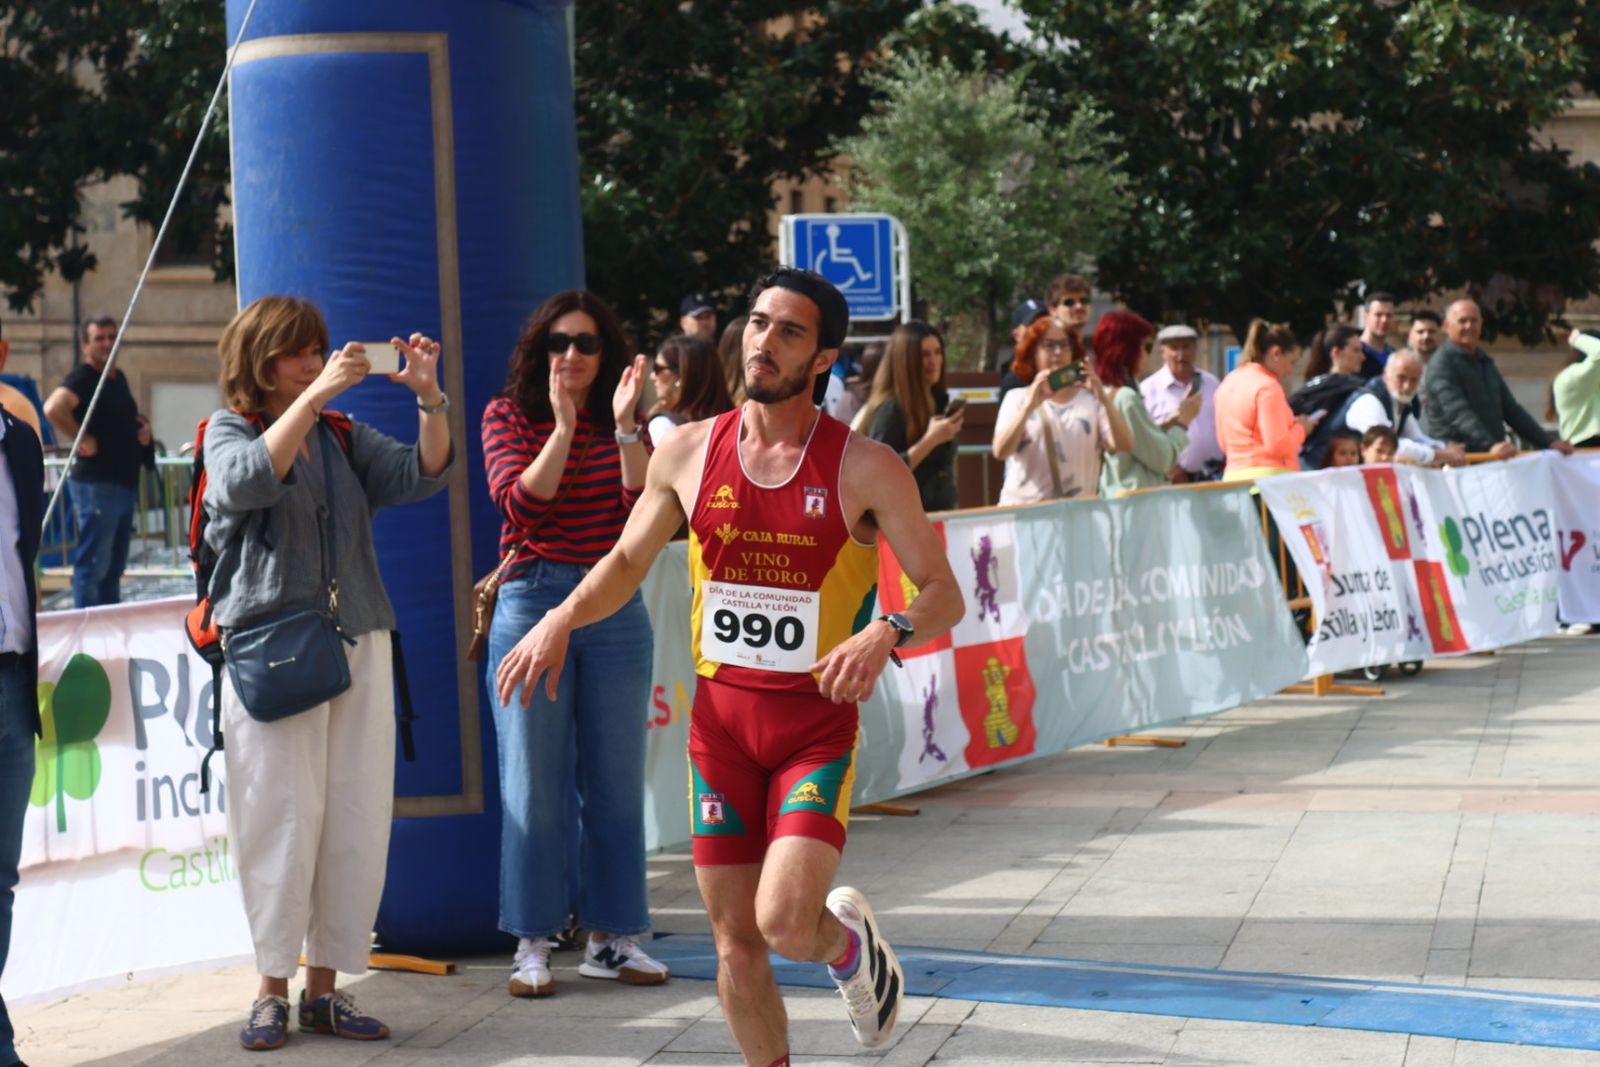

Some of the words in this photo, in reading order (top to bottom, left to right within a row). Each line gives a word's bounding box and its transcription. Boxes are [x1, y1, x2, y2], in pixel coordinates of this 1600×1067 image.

[742, 530, 773, 543] CAJA
[777, 533, 817, 546] RURAL
[1461, 509, 1551, 557] Plena
[740, 552, 790, 568] VINO
[1477, 546, 1557, 587] inclusión
[724, 567, 749, 581] DE
[753, 568, 808, 585] TORO
[709, 586, 724, 595] DÍA
[726, 589, 737, 597] DE
[740, 591, 751, 599] LA
[753, 591, 813, 604] COMUNIDAD
[721, 598, 762, 610] CASTILLA
[764, 603, 771, 611] Y
[772, 602, 798, 612] LEÓN
[1074, 579, 1105, 618] DE
[713, 609, 805, 651] 990
[1167, 619, 1185, 655] Y
